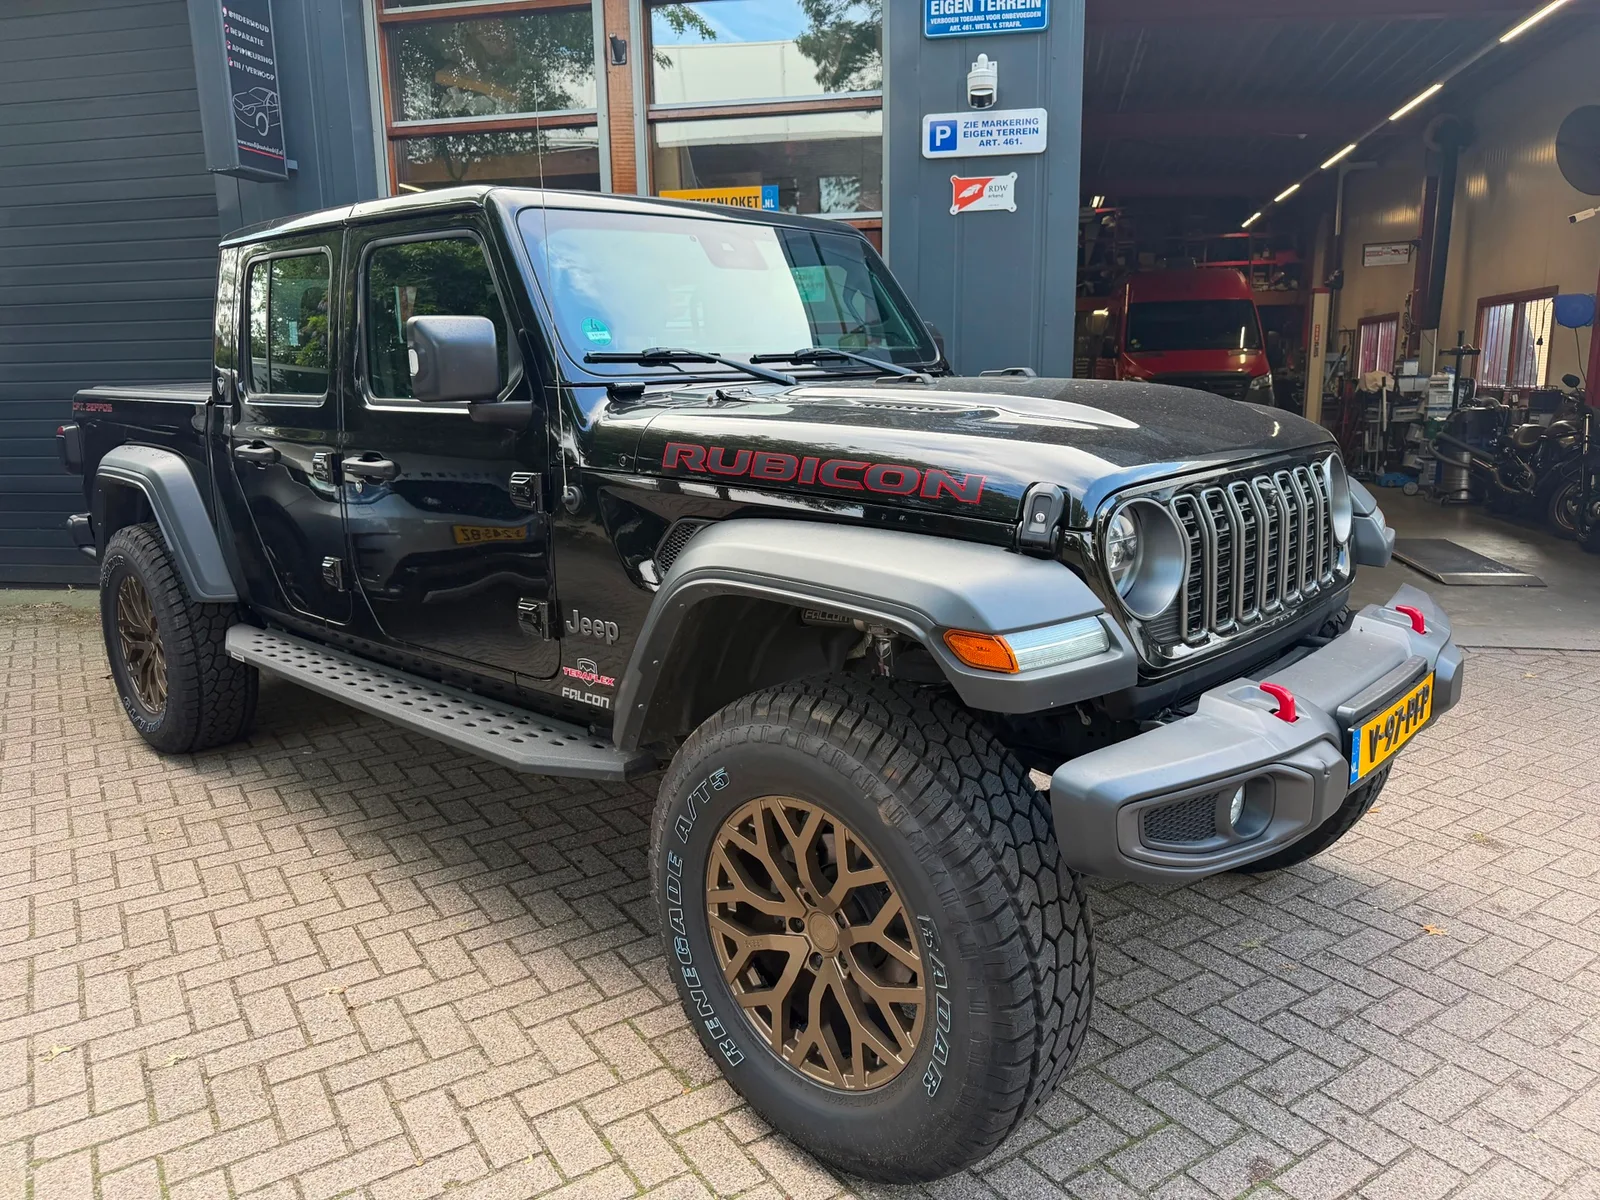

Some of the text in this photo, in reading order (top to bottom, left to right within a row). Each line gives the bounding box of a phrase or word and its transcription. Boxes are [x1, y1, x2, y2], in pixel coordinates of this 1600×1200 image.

[930, 0, 1042, 15] EIGEN TERREIN
[930, 16, 959, 24] VERBODEN
[1001, 11, 1042, 20] ONBEVOEGDEN
[230, 27, 264, 47] REPARATIE
[963, 117, 1039, 129] ZIE MARKERING
[963, 127, 1039, 138] EIGEN TERREIN
[935, 125, 952, 147] P
[979, 138, 1022, 147] ART. 461.
[988, 184, 1008, 193] RDW
[662, 442, 987, 504] RUBICON
[565, 609, 620, 646] Jeep
[562, 666, 616, 687] TERAFLEX
[561, 686, 610, 709] FALCON
[666, 766, 745, 1067] RENEGADE A/T5
[916, 914, 952, 1098] RADAR
